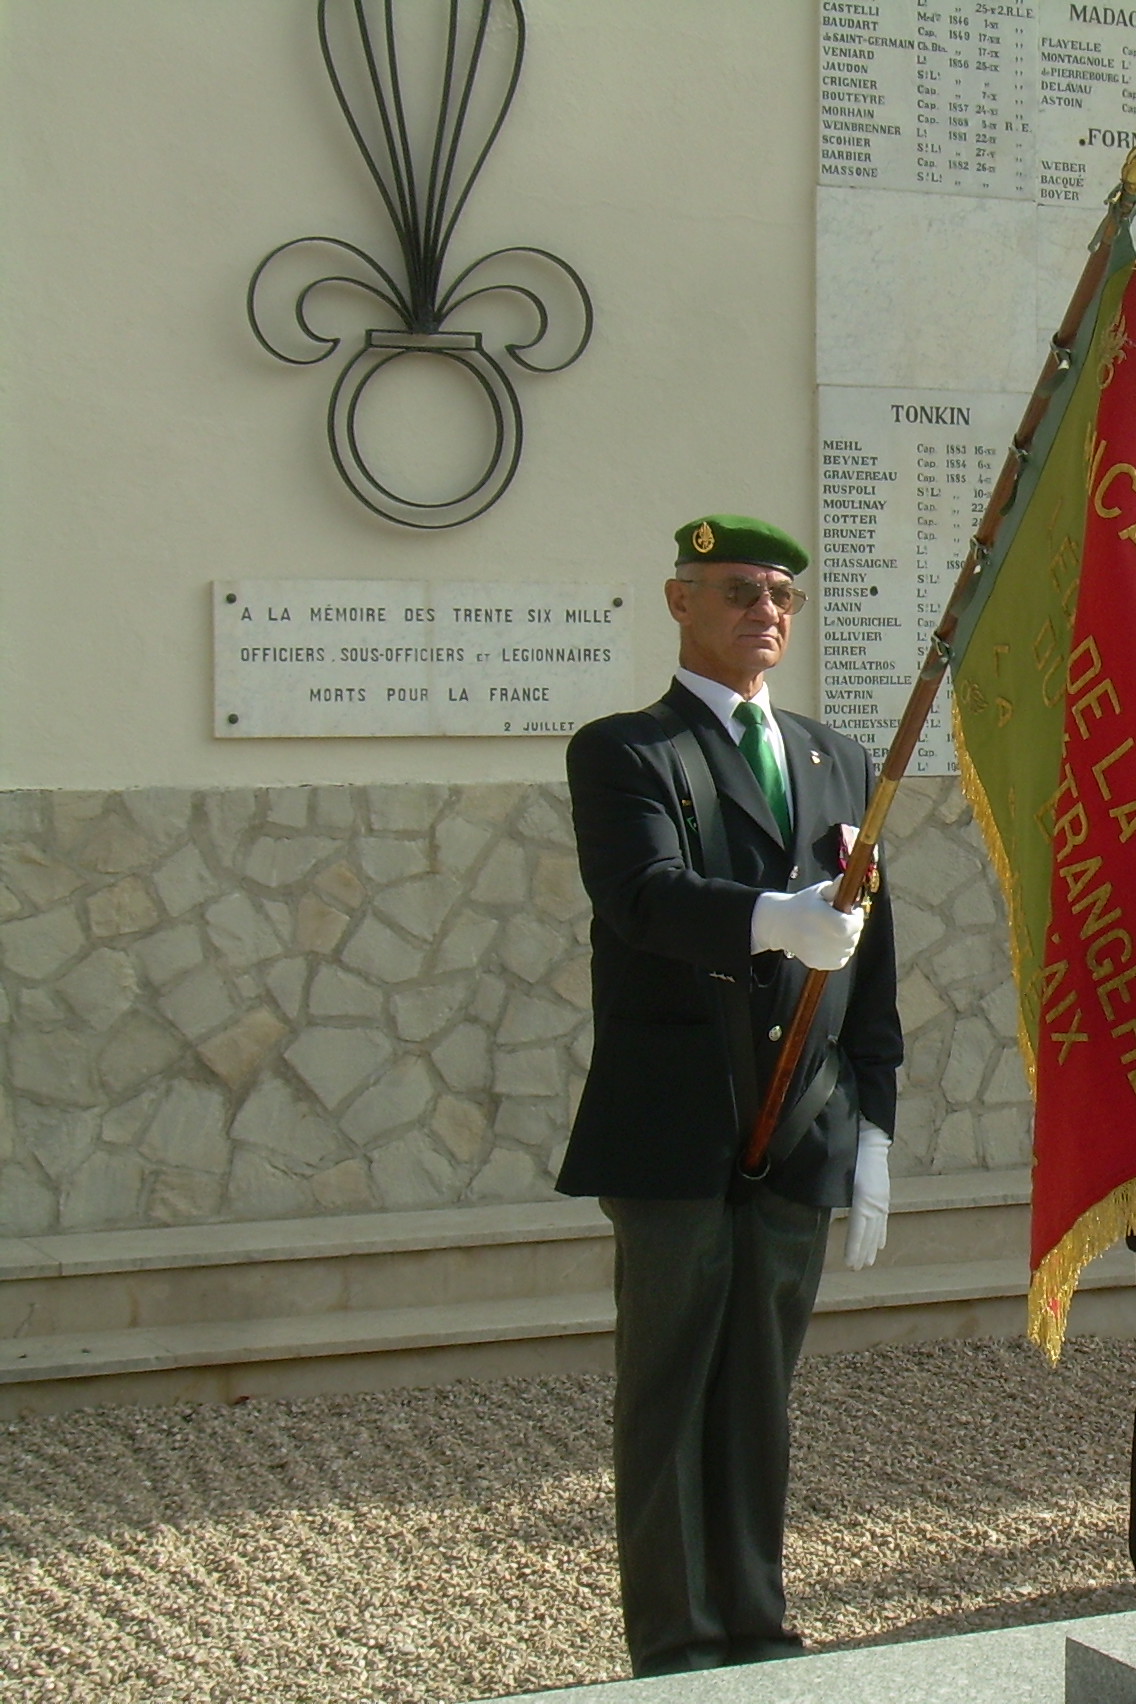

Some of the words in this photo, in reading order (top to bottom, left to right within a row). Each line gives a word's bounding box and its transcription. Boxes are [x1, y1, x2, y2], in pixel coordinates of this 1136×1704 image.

[823, 2, 879, 16] CASTELLI
[823, 16, 879, 32] BAUDART
[1041, 37, 1102, 53] FLAYELLE
[822, 46, 875, 60] VENIARD
[1041, 52, 1115, 69] MONTAGNOLE
[822, 61, 868, 74] JAUDON
[822, 76, 877, 90] CRIGNIER
[1041, 81, 1093, 95] DELAVAU
[822, 90, 885, 105] BOUTEYRE
[1041, 96, 1083, 109] ASTOIN
[821, 105, 875, 119] MORHAIN
[822, 120, 901, 136] WEINBRENNER
[822, 135, 871, 148] SCOHIER
[822, 149, 872, 163] BARBIER
[821, 164, 878, 178] MASSONE
[1041, 160, 1087, 174] WEBER
[1040, 188, 1080, 201] BOYER
[891, 403, 971, 426] TONKIN
[823, 440, 862, 452] MEHL
[823, 455, 879, 467] BEYNET
[823, 469, 898, 482] GRAVEREAU
[823, 484, 876, 496] RUSPOLI
[823, 499, 887, 510] MOULINAY
[823, 513, 878, 525] COTTER
[823, 528, 876, 539] BRUNET
[823, 542, 876, 553] GUENOT
[823, 557, 898, 569] CHASSAIGNE
[823, 571, 867, 583] HENRY
[823, 586, 869, 598] BRISSE
[823, 601, 862, 612] JANIN
[240, 607, 252, 621] A
[268, 607, 292, 621] LA
[310, 604, 387, 621] MÉMOIRE
[405, 608, 436, 622] DES
[453, 608, 514, 623] TRENTE
[527, 609, 552, 623] SIX
[565, 609, 612, 623] MILLE
[824, 630, 882, 641] OLLIVIER
[340, 647, 465, 662] SOUS-OFFICIERS
[502, 648, 612, 662] LEGIONNAIRES
[824, 645, 867, 656] EHRER
[824, 659, 896, 671] CAMILATROS
[824, 674, 913, 685] CHAUDOREILLE
[309, 687, 367, 702] MORTS
[387, 687, 429, 702] POUR
[448, 688, 470, 702] LA
[490, 688, 550, 702] FRANCE
[824, 688, 874, 700] WATRIN
[1066, 636, 1121, 740] DE
[824, 703, 879, 715] DUCHIER
[503, 722, 512, 732] 2
[523, 722, 576, 732] JUILLET
